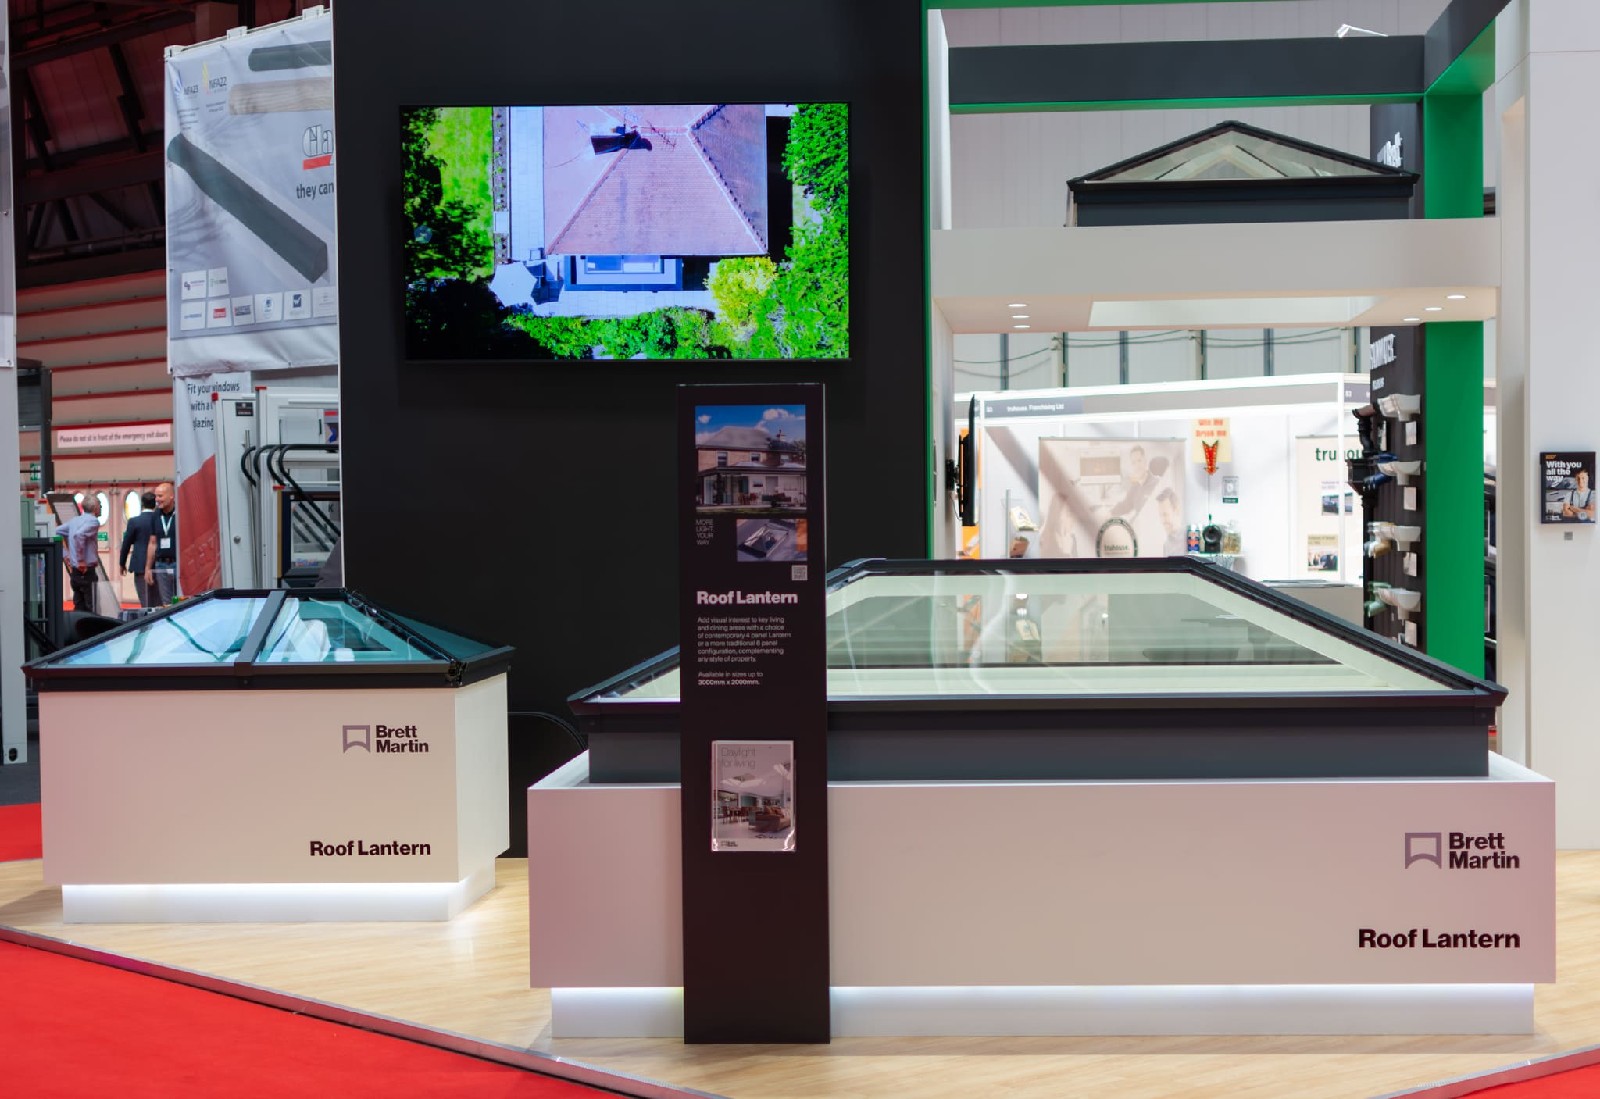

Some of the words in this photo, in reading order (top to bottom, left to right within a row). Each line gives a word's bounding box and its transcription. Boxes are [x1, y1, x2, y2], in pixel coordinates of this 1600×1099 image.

[296, 184, 316, 200] they
[319, 182, 334, 194] can
[187, 384, 196, 394] Fit
[198, 385, 211, 396] your
[212, 381, 240, 392] windows
[191, 400, 205, 411] with
[193, 418, 214, 430] glazing
[696, 591, 734, 604] Roof
[736, 591, 798, 604] Lantern
[770, 616, 784, 624] living
[376, 725, 417, 738] Brett
[376, 740, 429, 753] Martin
[721, 747, 755, 758] Daylight
[1449, 832, 1505, 850] Brett
[310, 840, 354, 856] Roof
[358, 840, 430, 856] Lantern
[1449, 851, 1520, 869] Martin
[1358, 928, 1417, 948] Roof
[1422, 928, 1520, 948] Lantern
